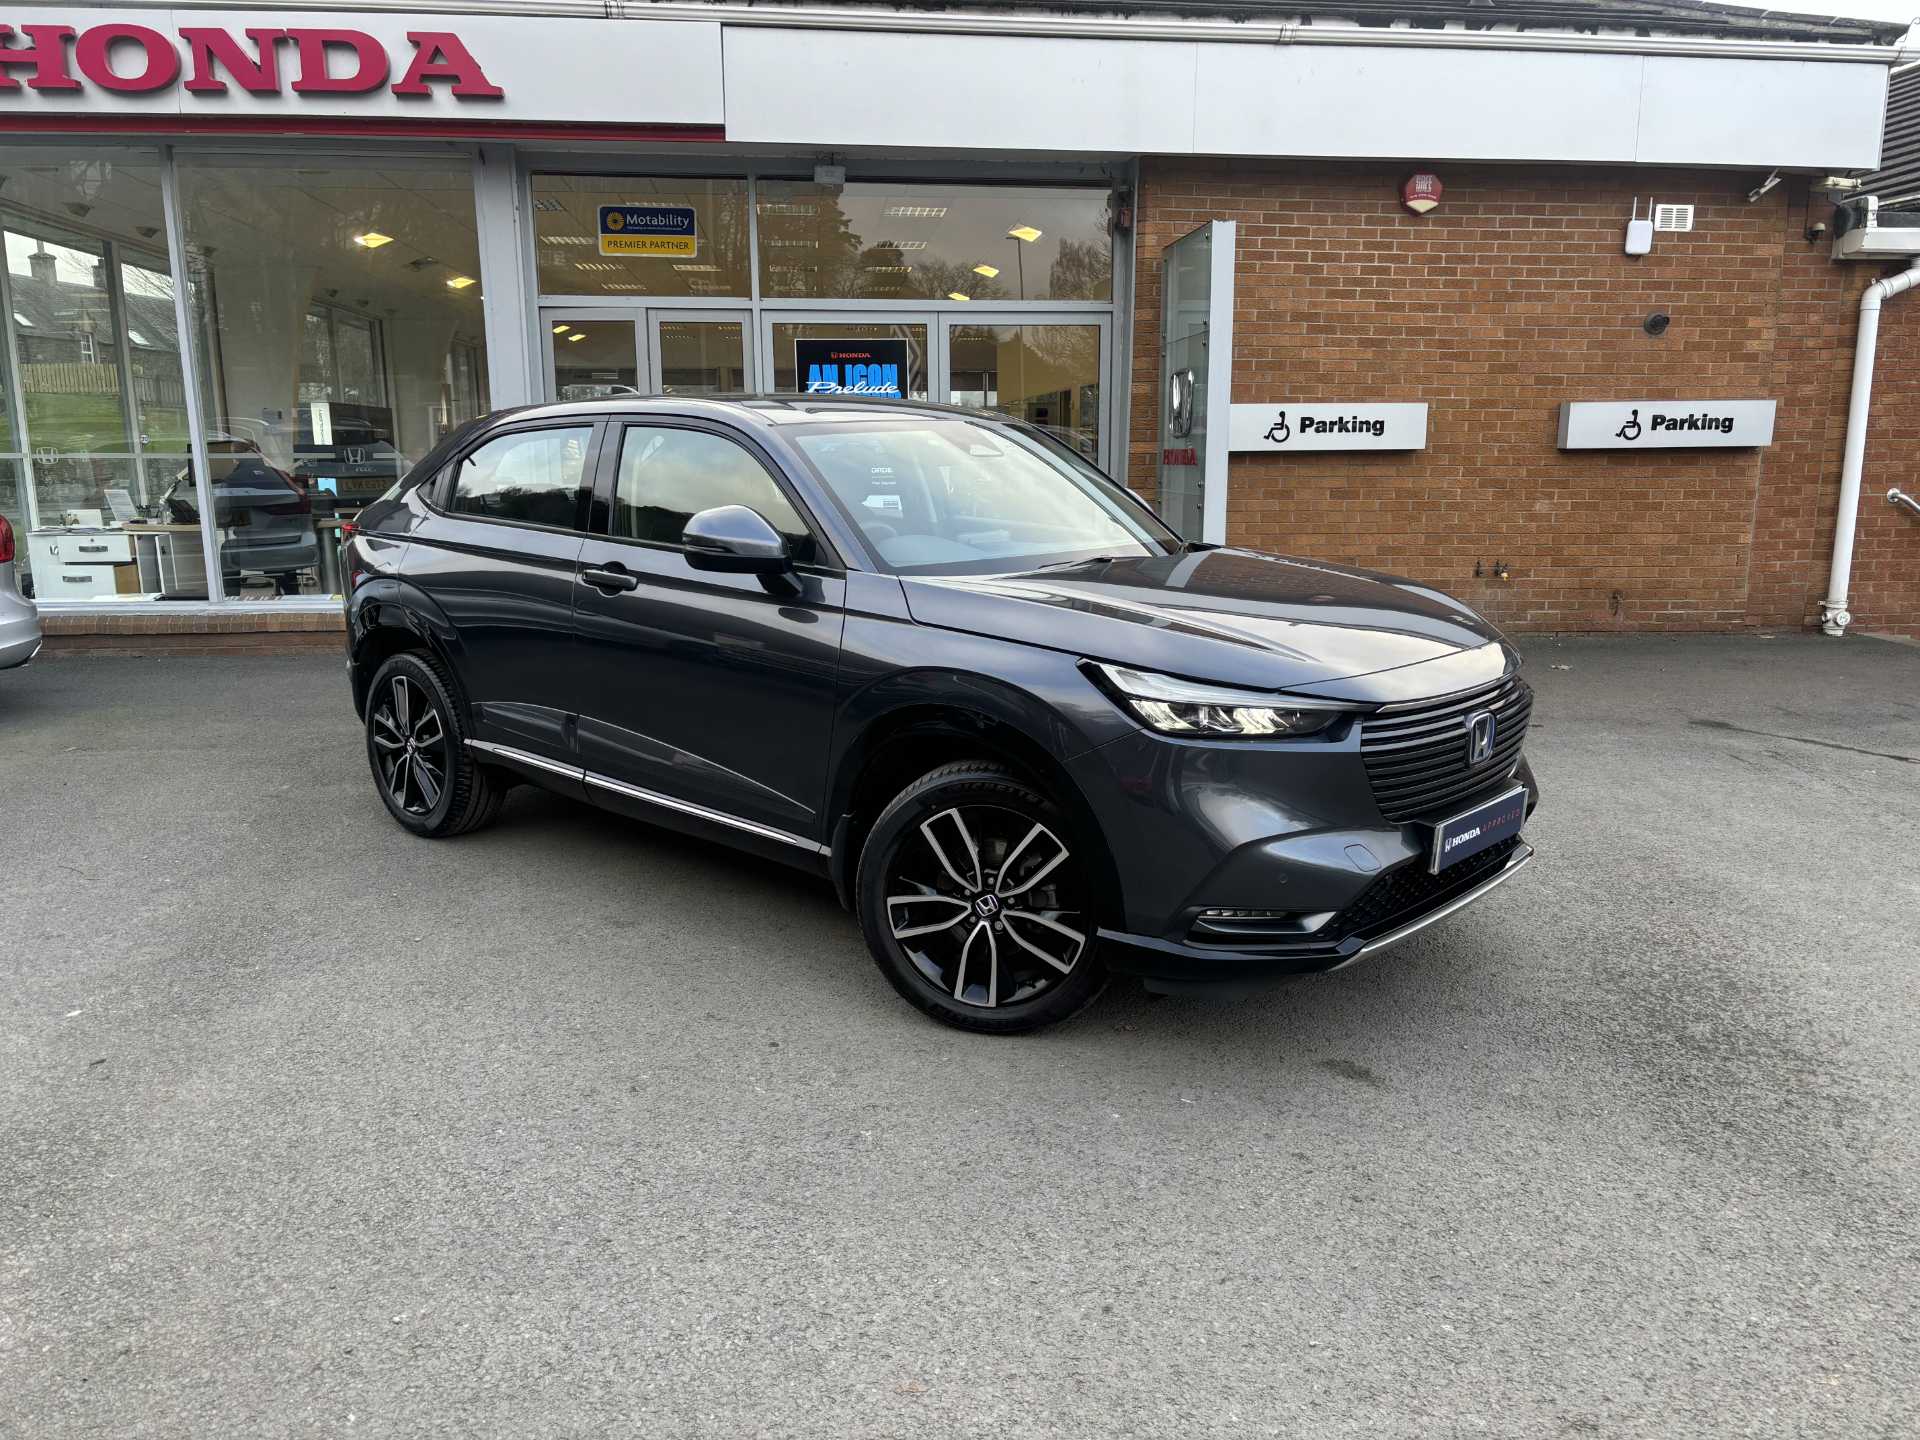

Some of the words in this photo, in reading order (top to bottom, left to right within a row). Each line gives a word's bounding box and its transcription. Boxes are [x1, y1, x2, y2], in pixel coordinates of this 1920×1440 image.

[0, 24, 504, 98] HONDA
[626, 213, 690, 229] Motability
[607, 240, 648, 249] PREMIER
[649, 241, 689, 250] PARTNER
[805, 381, 899, 393] Prelude
[807, 364, 839, 394] AN
[844, 364, 898, 394] ICON
[1300, 416, 1385, 436] Parking
[1651, 414, 1734, 433] Parking
[1452, 827, 1480, 847] HONDA
